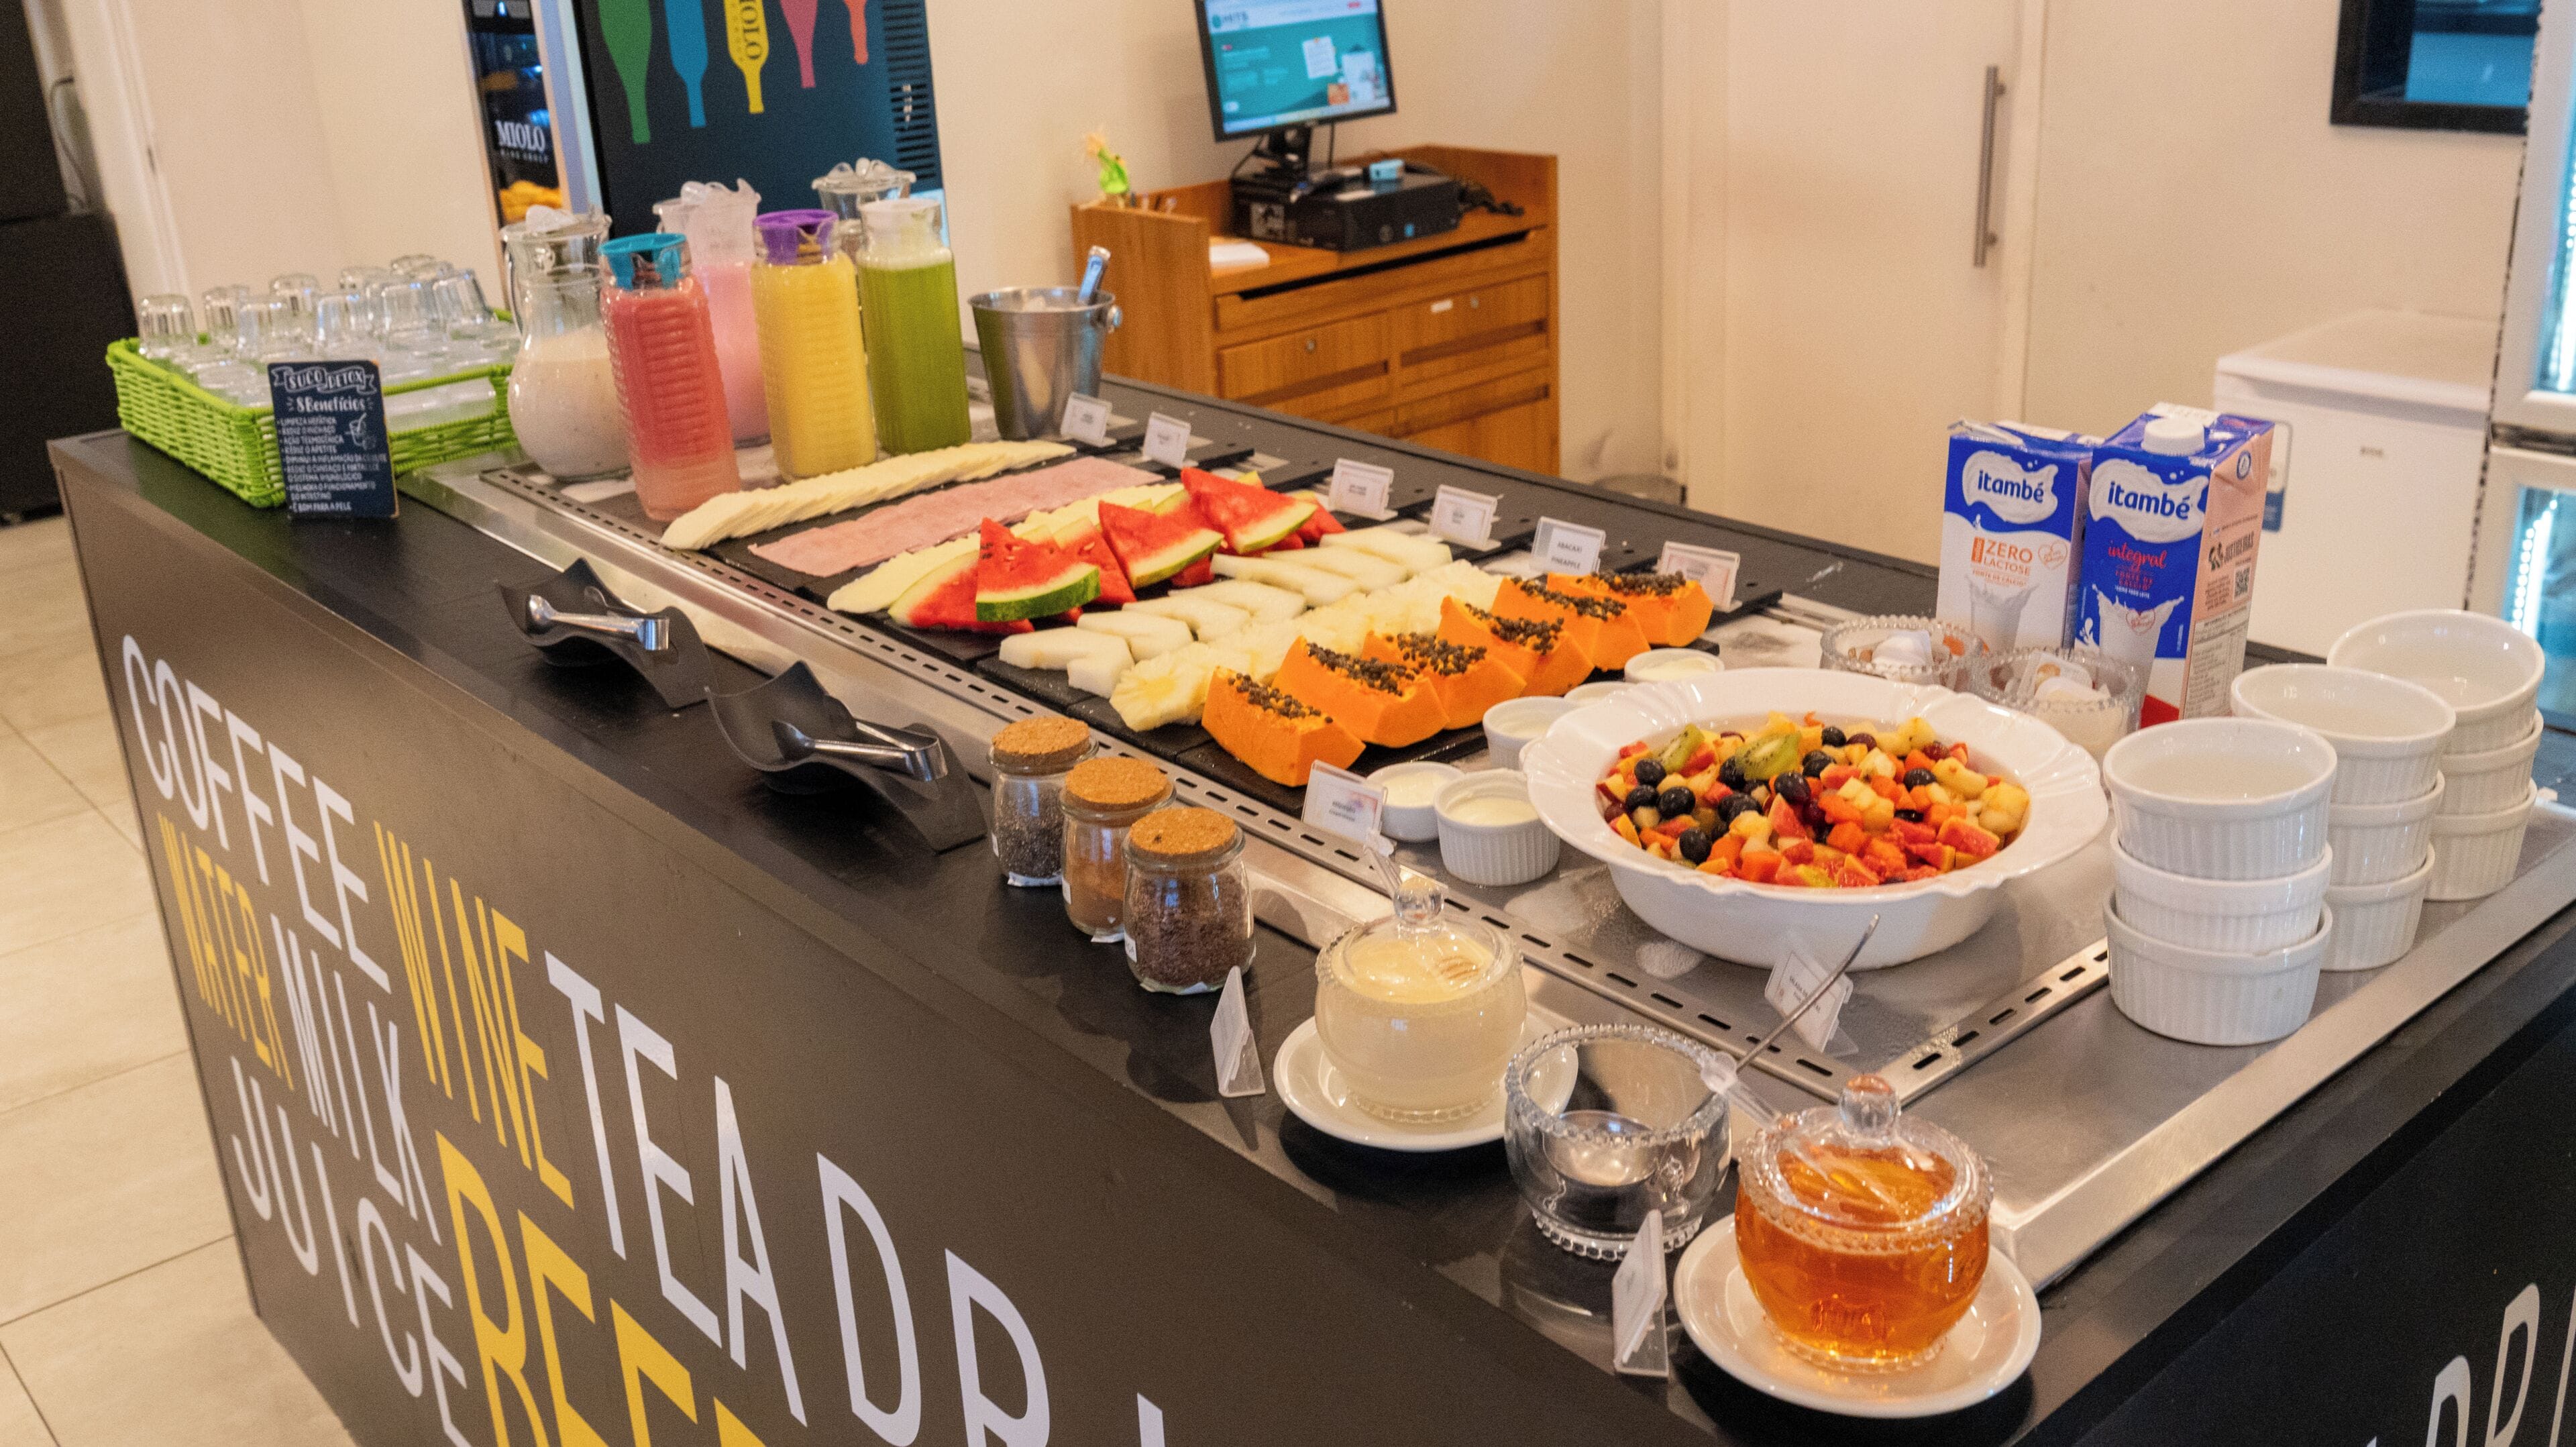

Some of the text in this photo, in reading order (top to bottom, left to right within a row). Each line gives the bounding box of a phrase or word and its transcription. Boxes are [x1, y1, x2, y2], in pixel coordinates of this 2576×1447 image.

[495, 119, 546, 154] MIOLO
[288, 369, 364, 390] SUCO DETOX
[305, 395, 366, 413] Benefícios
[311, 444, 337, 454] APETITE
[1977, 469, 2044, 504] itambé
[2107, 480, 2191, 521] itambé
[1551, 555, 1581, 570] PINEAPPLE
[1557, 541, 1582, 553] ABACAXI
[1986, 539, 2033, 564] ZERO
[2108, 539, 2168, 572] integral
[1984, 556, 2031, 577] LACTOSE
[122, 634, 392, 994] COFFEE
[157, 810, 442, 1246] WATER MILK
[373, 820, 575, 1210] WINE
[545, 950, 808, 1428] TEA
[230, 1055, 476, 1447] JUICE
